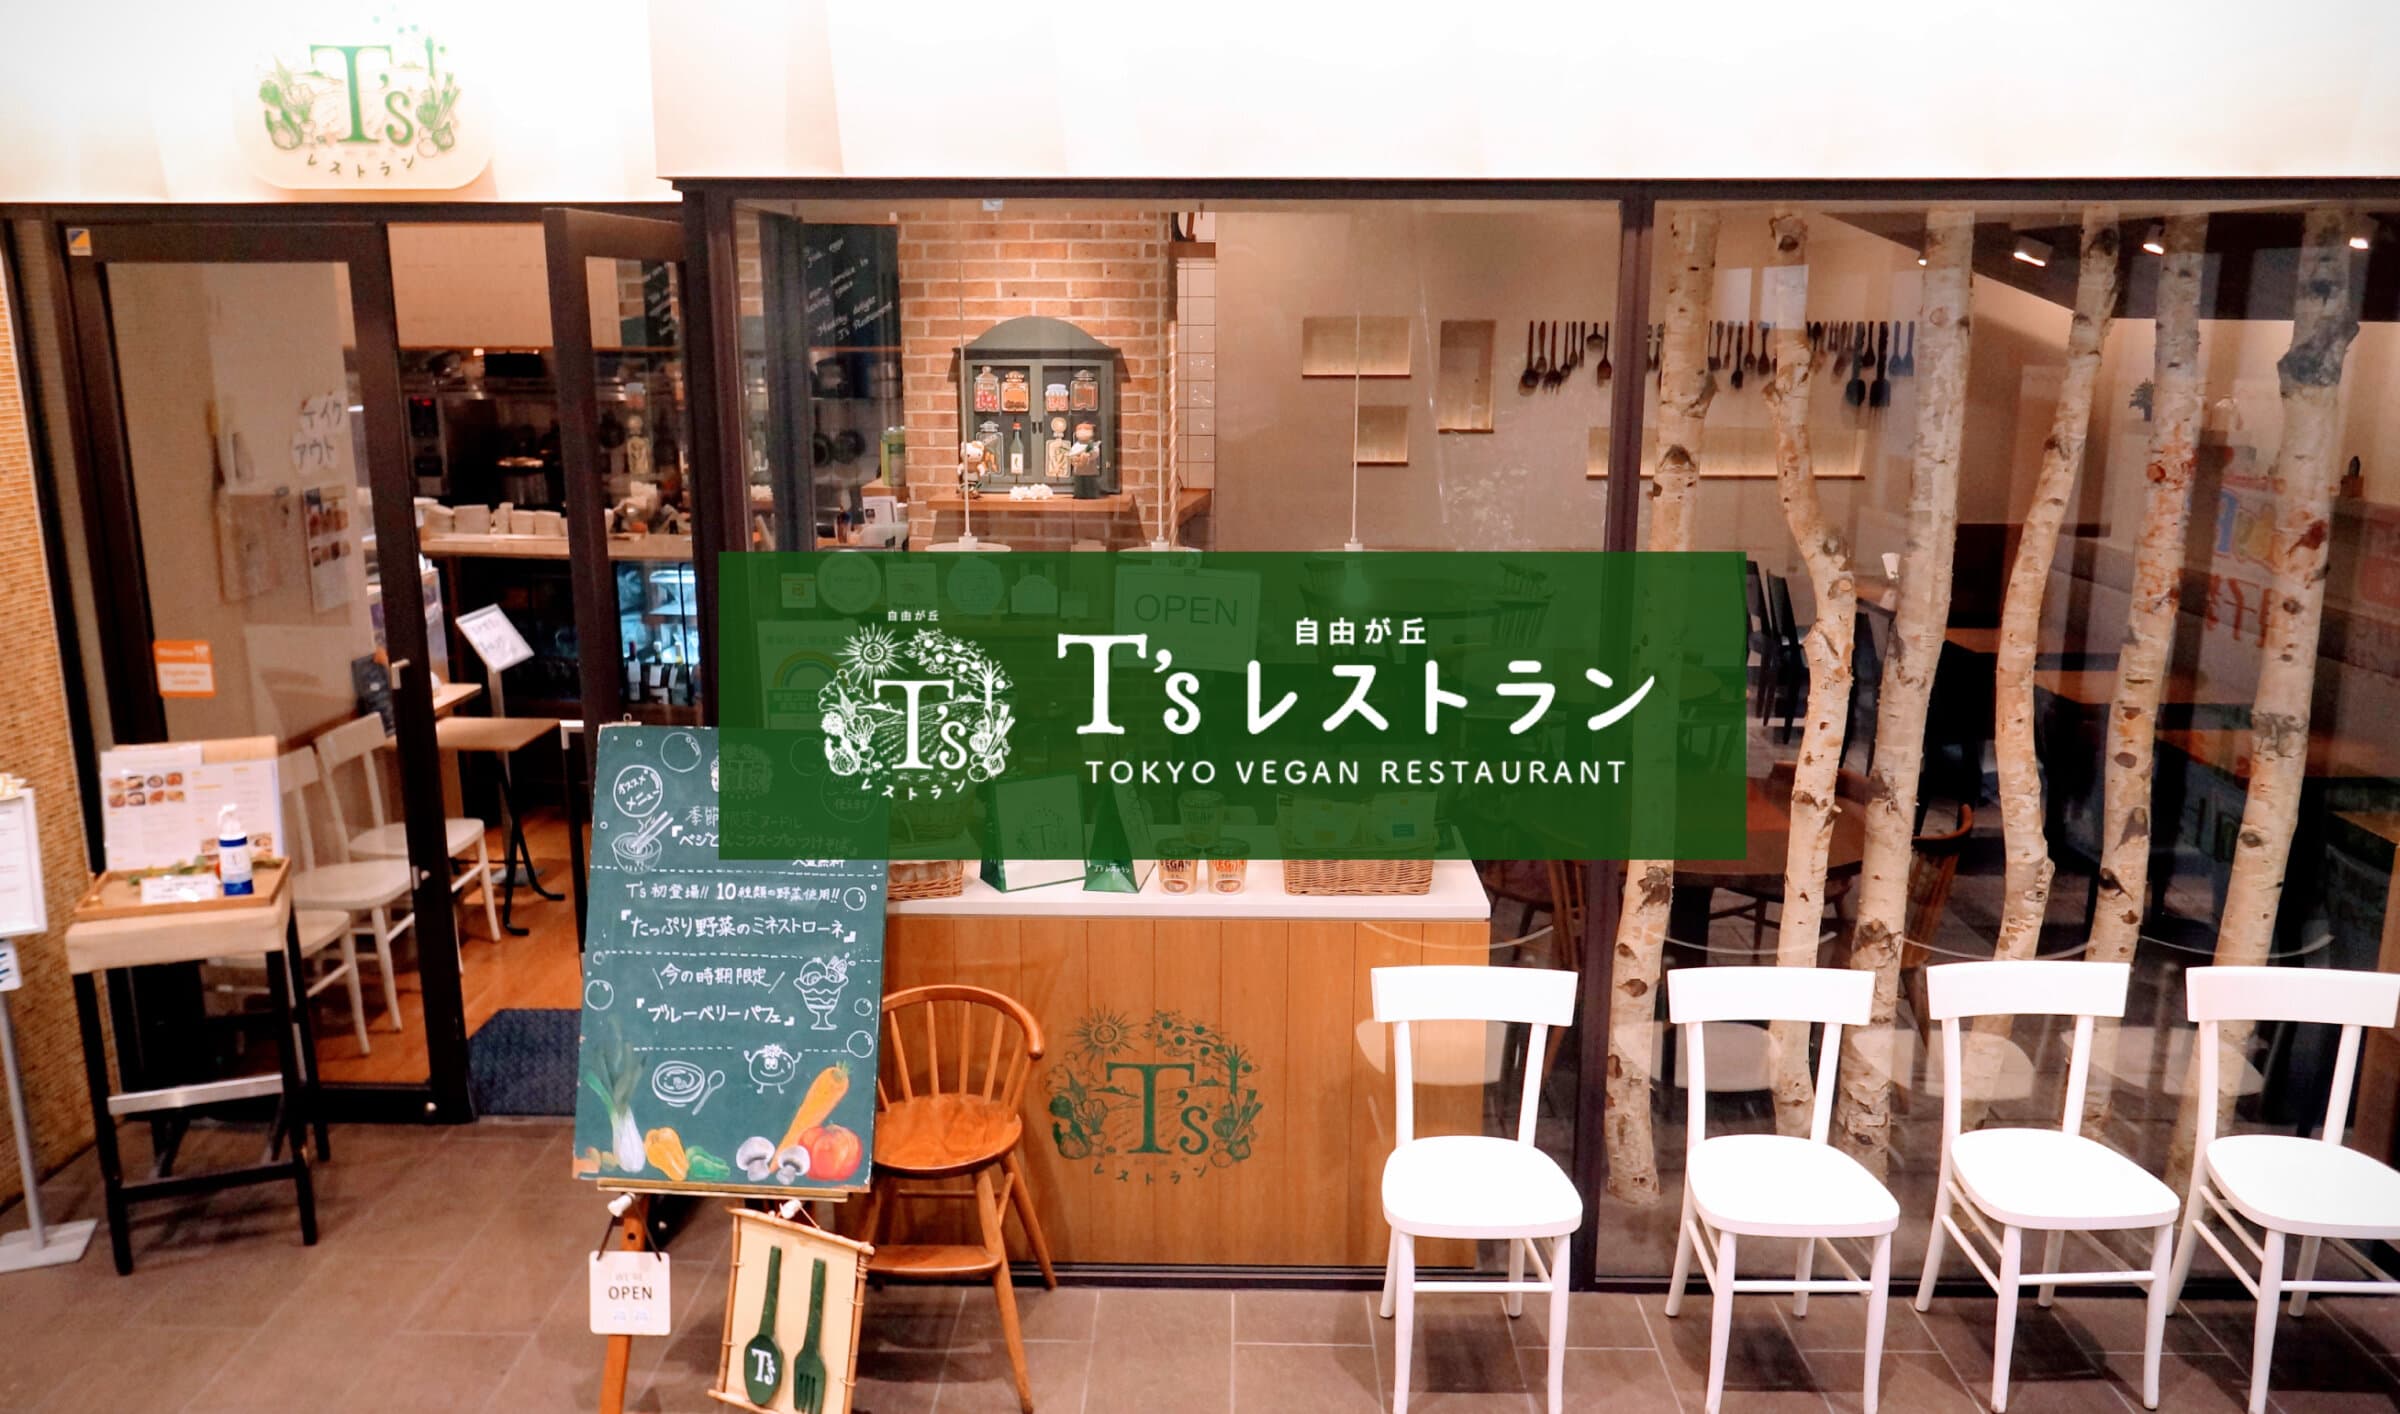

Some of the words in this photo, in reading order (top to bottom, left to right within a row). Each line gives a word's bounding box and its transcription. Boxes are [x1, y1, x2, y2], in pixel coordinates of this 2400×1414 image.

[309, 44, 414, 145] T's
[307, 153, 415, 178] レストラン
[1134, 593, 1239, 628] OPEN
[660, 962, 772, 988] 今の時期限定
[1105, 1062, 1210, 1155] T's
[1094, 1164, 1208, 1185] レストラン
[608, 1285, 653, 1301] OPEN
